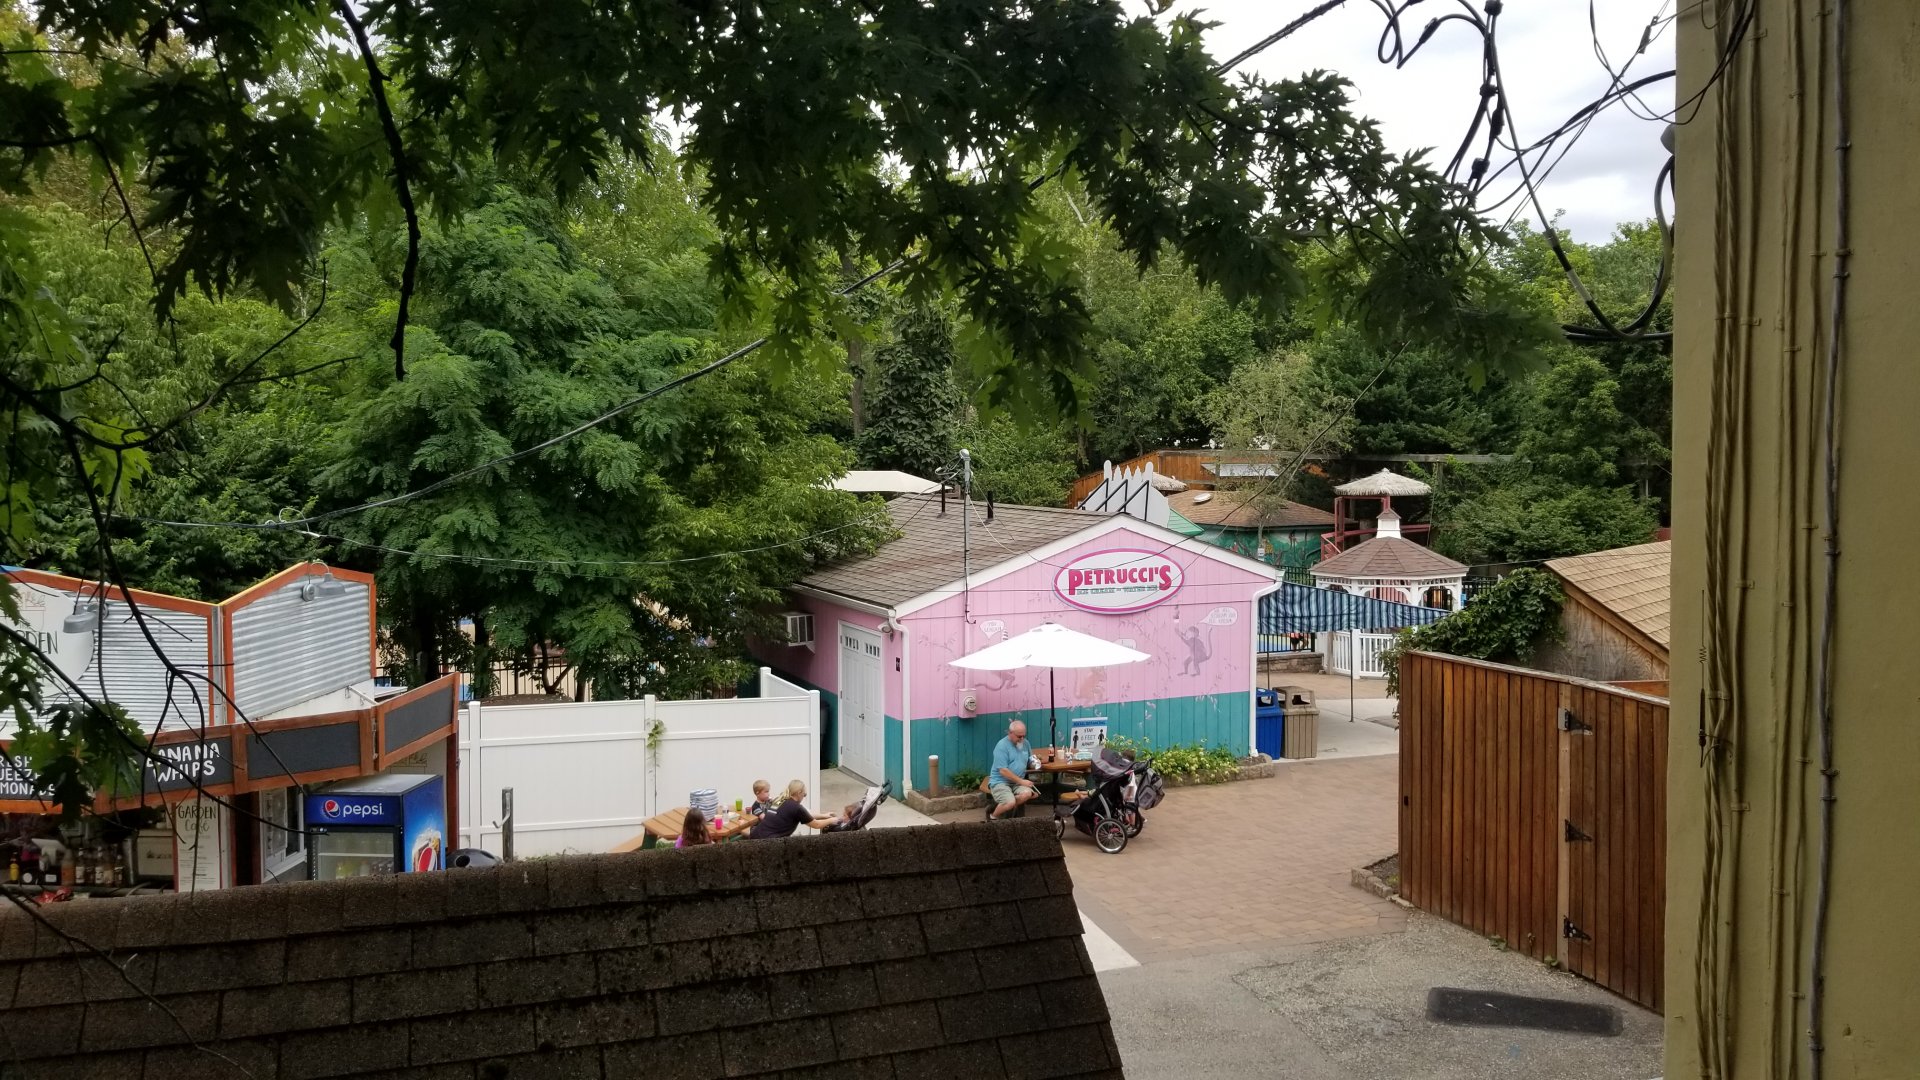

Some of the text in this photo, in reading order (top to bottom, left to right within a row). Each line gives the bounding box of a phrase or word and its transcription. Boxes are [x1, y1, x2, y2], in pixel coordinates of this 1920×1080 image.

[1068, 565, 1172, 596] PETRUCCI'S
[153, 760, 215, 782] WHIPS
[178, 805, 217, 819] GARDEN
[343, 803, 383, 818] pepsi
